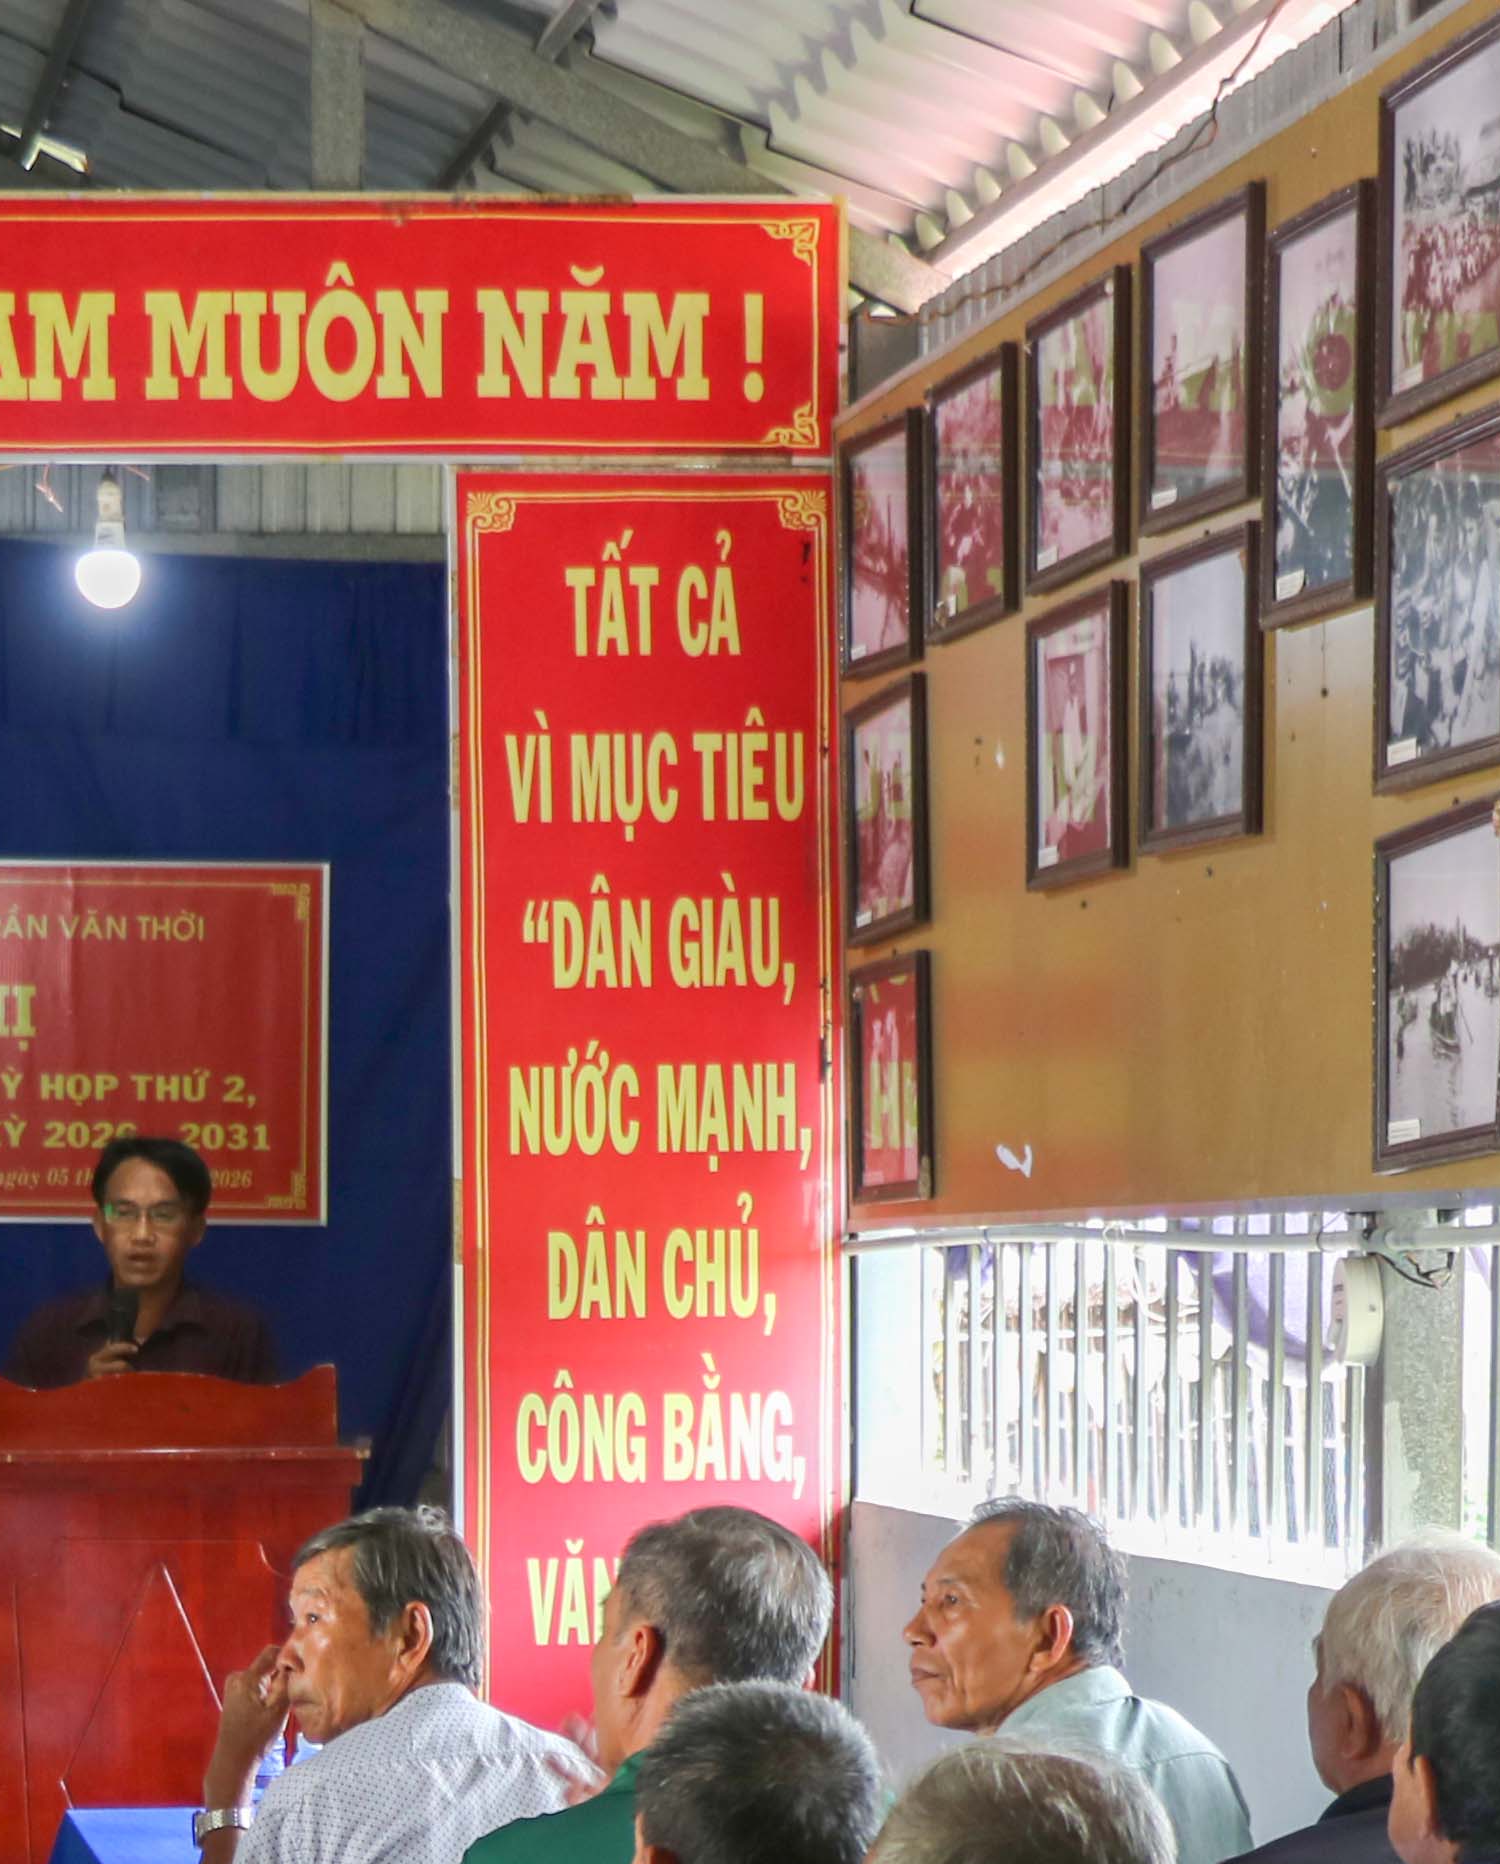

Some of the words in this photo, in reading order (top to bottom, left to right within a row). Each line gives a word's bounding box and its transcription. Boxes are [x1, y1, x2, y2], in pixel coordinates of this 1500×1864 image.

[145, 261, 448, 402] MUÔN
[477, 264, 709, 400] NĂM
[744, 293, 763, 402] !
[566, 529, 659, 656] TẤT
[677, 530, 740, 656] CẢ
[504, 710, 552, 823] VÌ
[571, 732, 678, 842] MỤC
[693, 707, 804, 821] TIÊU
[60, 908, 127, 941] VĂN
[137, 910, 205, 943] THỜI
[669, 873, 795, 1005] GIÀU,
[39, 1073, 120, 1108] HỌP
[133, 1063, 212, 1103] THỨ
[223, 1076, 257, 1108] 2,
[180, 1122, 270, 1153] 2031
[509, 1041, 639, 1155] NƯỚC
[657, 1063, 811, 1171] MẠNH,
[548, 1207, 646, 1320] DÂN
[663, 1192, 775, 1335] CHỦ,
[516, 1370, 646, 1484] CÔNG
[663, 1353, 805, 1499] BẰNG,
